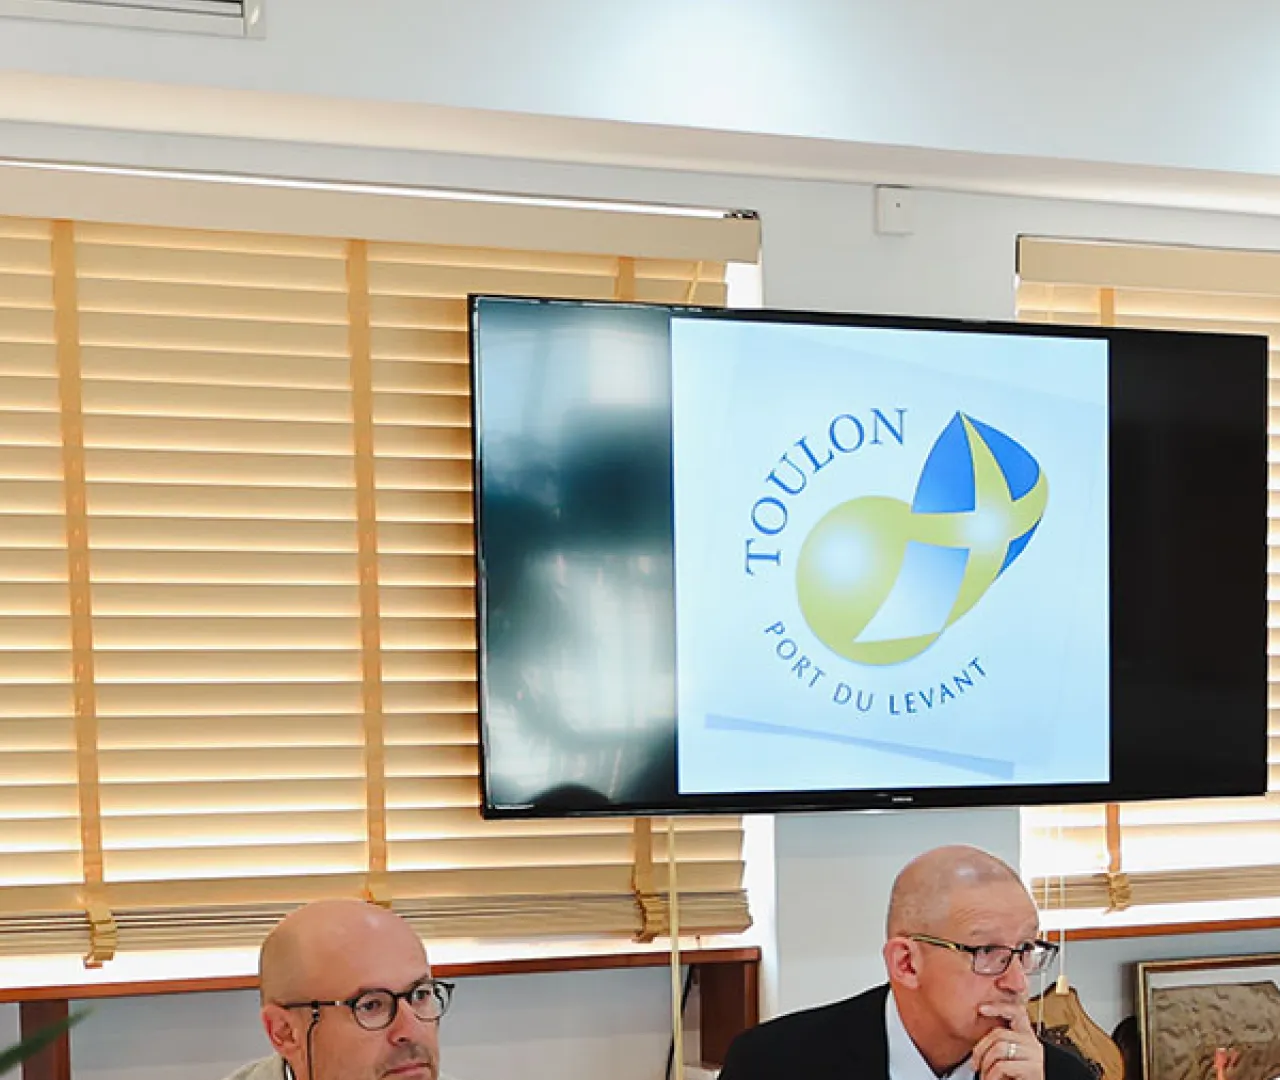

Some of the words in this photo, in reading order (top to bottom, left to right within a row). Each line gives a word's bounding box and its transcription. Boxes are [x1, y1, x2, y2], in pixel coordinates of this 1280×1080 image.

[745, 408, 907, 576] TOULON
[764, 620, 826, 688] PORT
[833, 682, 874, 712] DU
[889, 657, 986, 715] LEVANT
